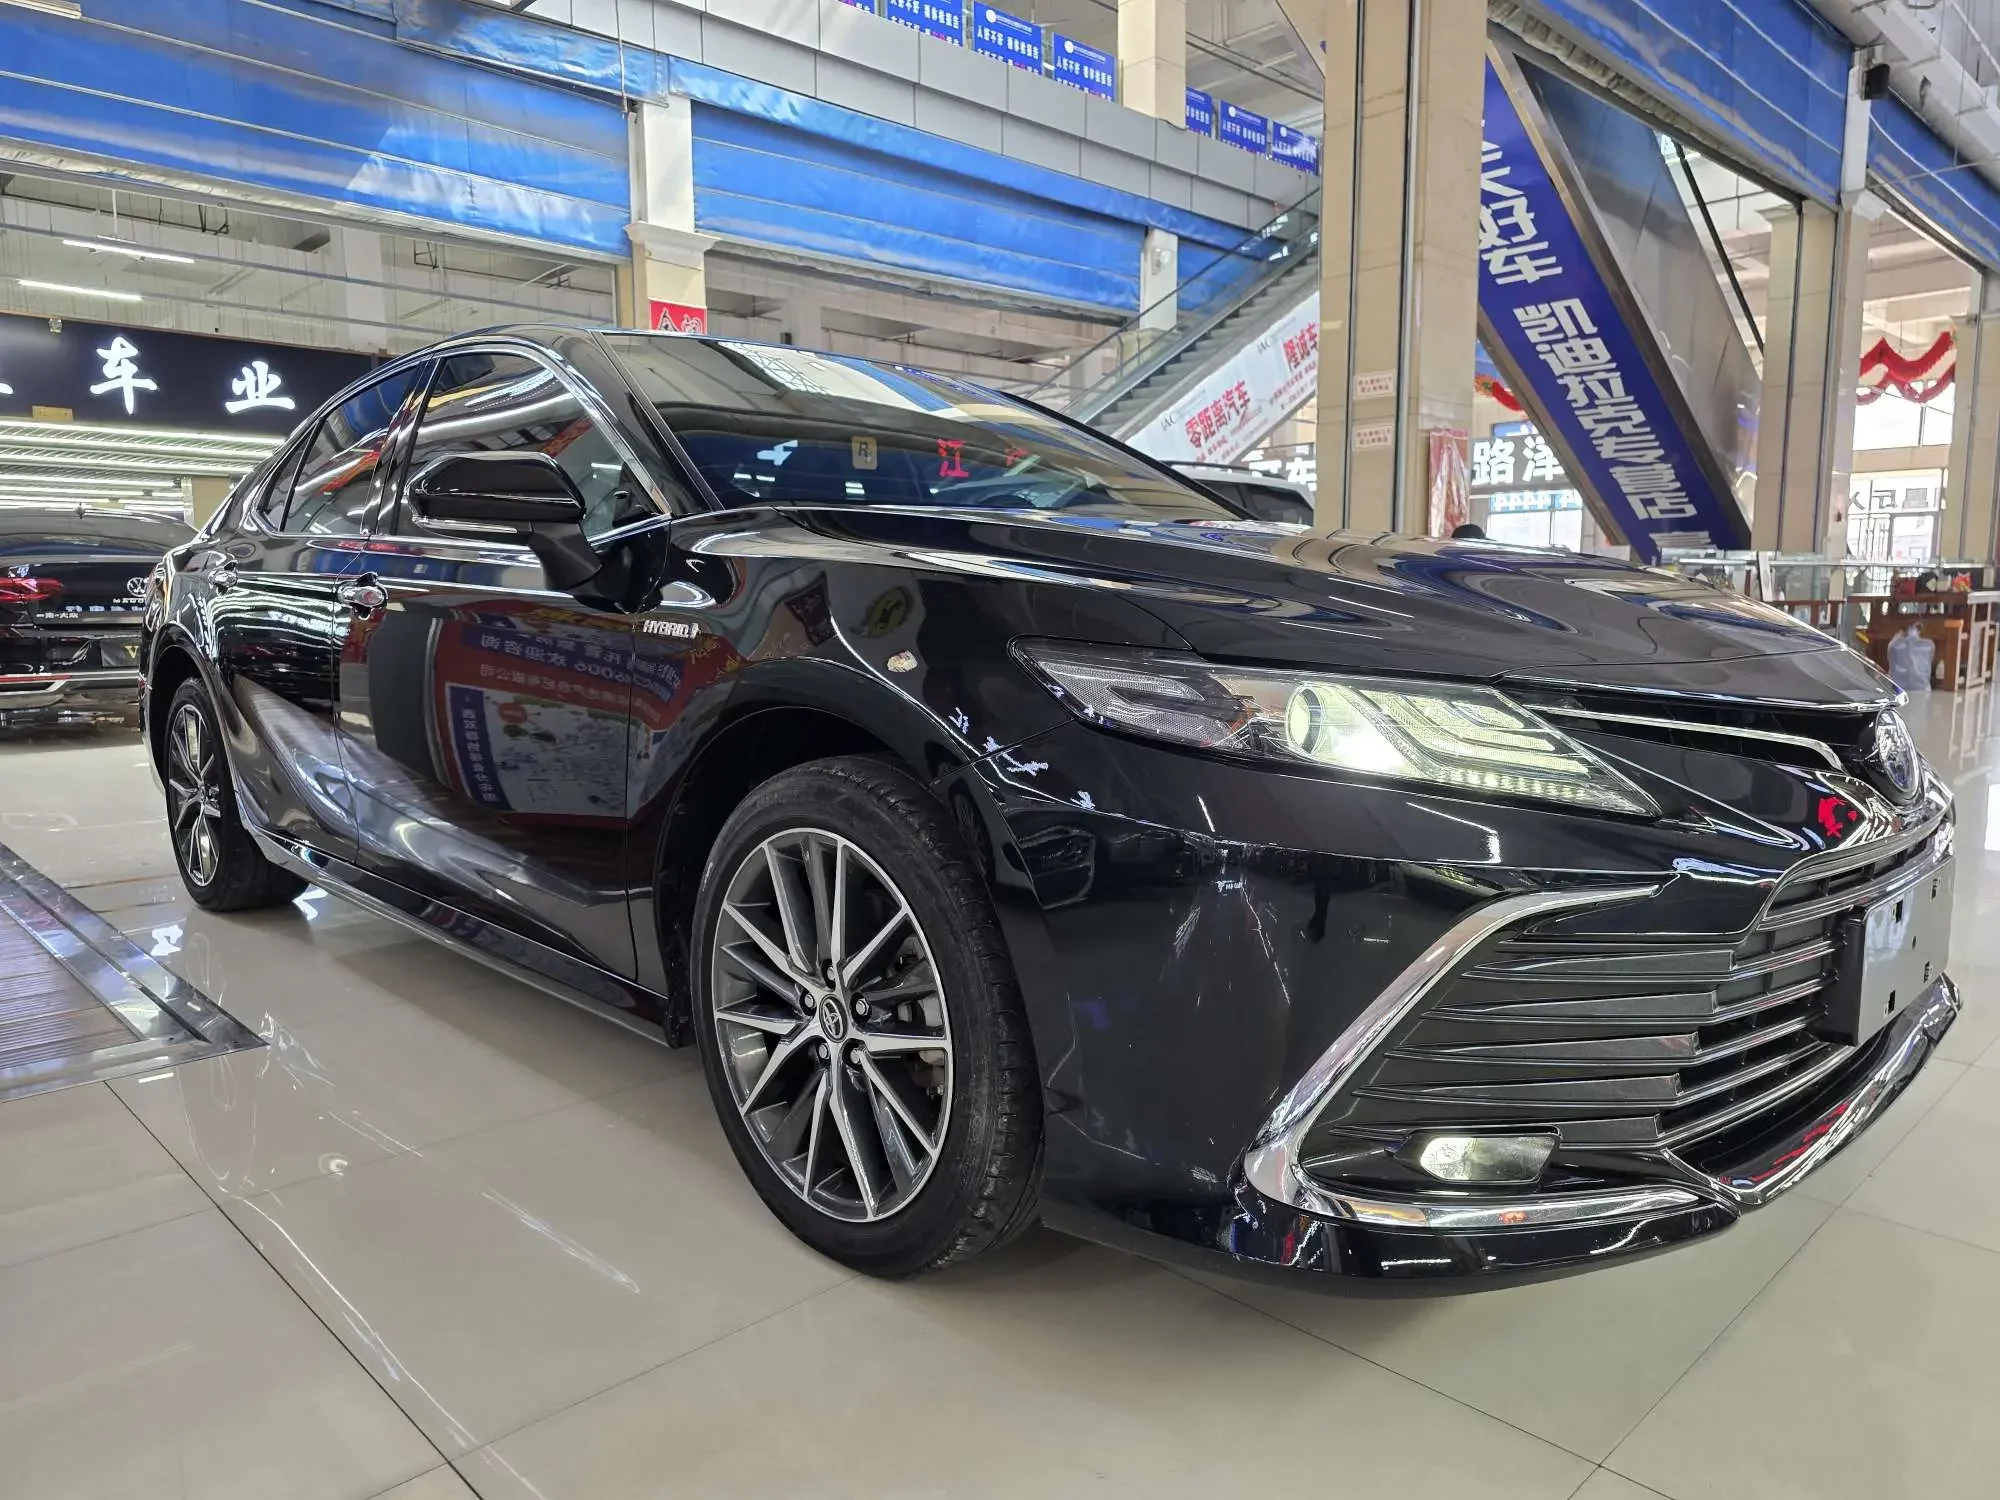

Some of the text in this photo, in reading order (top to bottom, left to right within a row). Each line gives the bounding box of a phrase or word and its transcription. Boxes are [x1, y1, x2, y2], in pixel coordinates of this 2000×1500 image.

[0, 336, 296, 415] 车业
[1513, 298, 1698, 520] 凯迪拉克专营店
[643, 619, 691, 638] HYBRID
